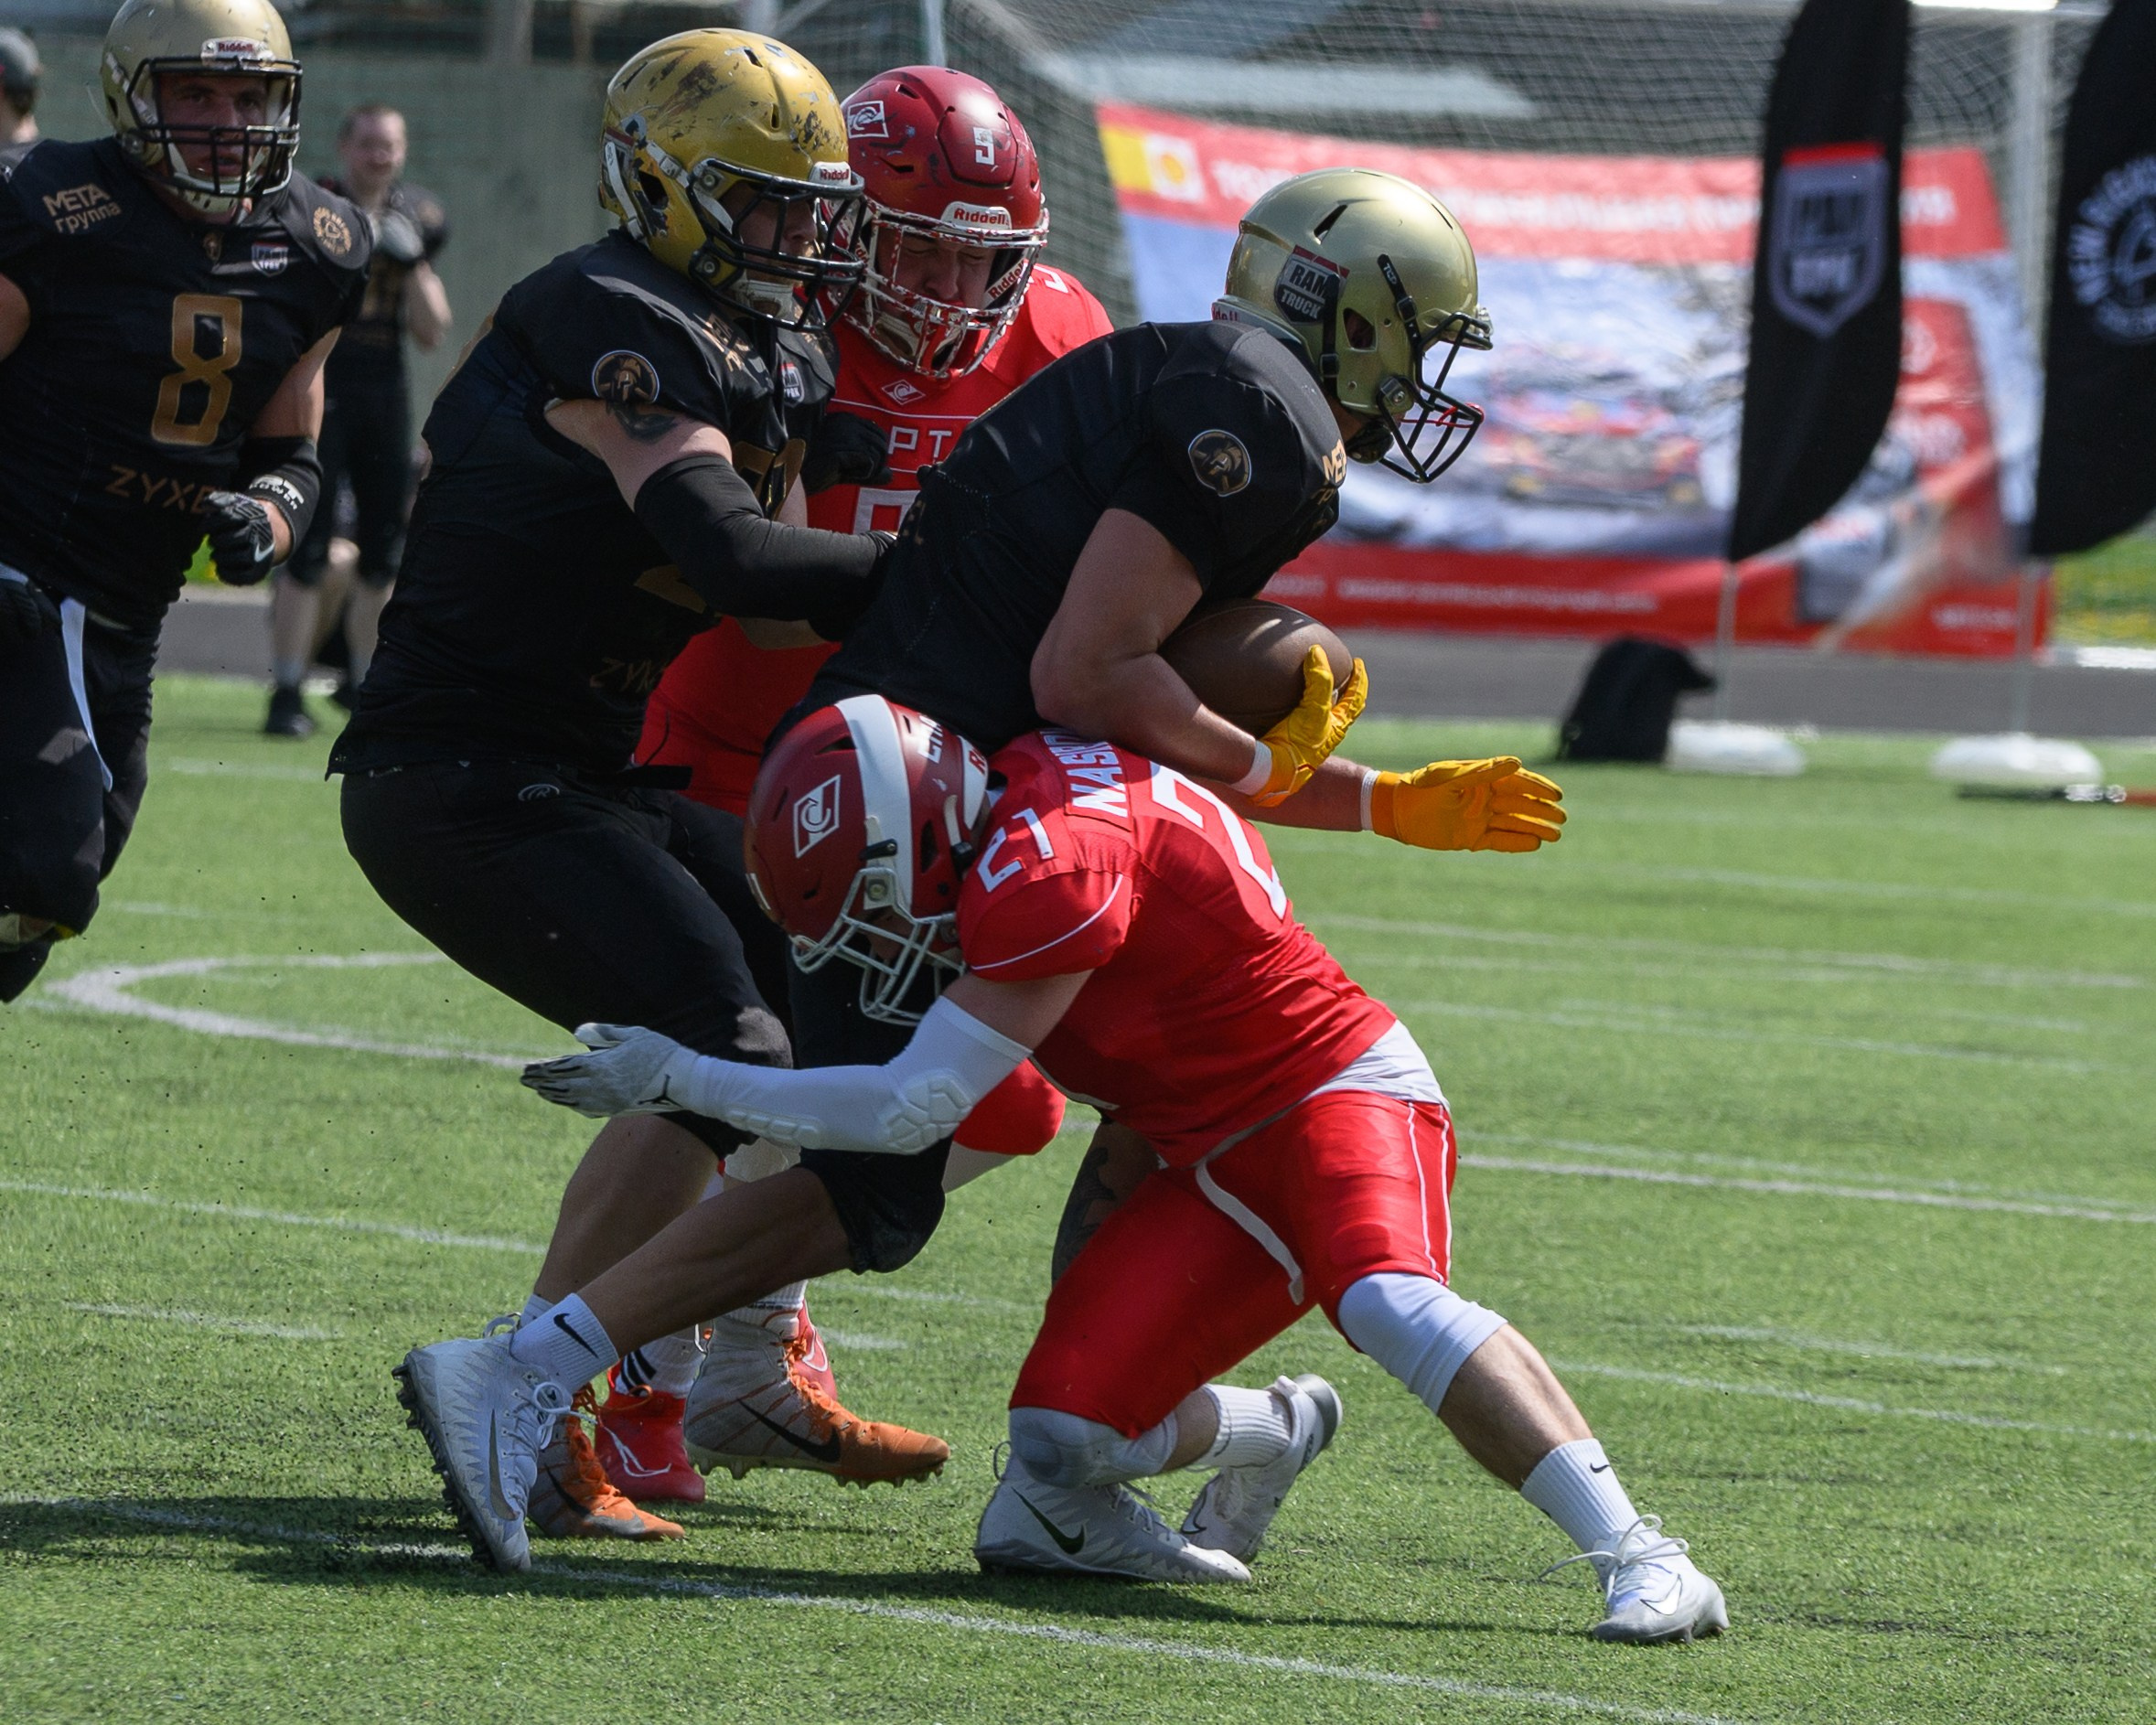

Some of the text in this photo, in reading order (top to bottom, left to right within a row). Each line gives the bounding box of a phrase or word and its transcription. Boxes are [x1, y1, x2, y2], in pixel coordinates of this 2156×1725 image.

[953, 208, 1006, 225] Riddell
[989, 260, 1024, 300] Ridde
[1281, 288, 1322, 319] TRUCK
[151, 293, 242, 445] 8
[105, 464, 220, 513] ZYXE
